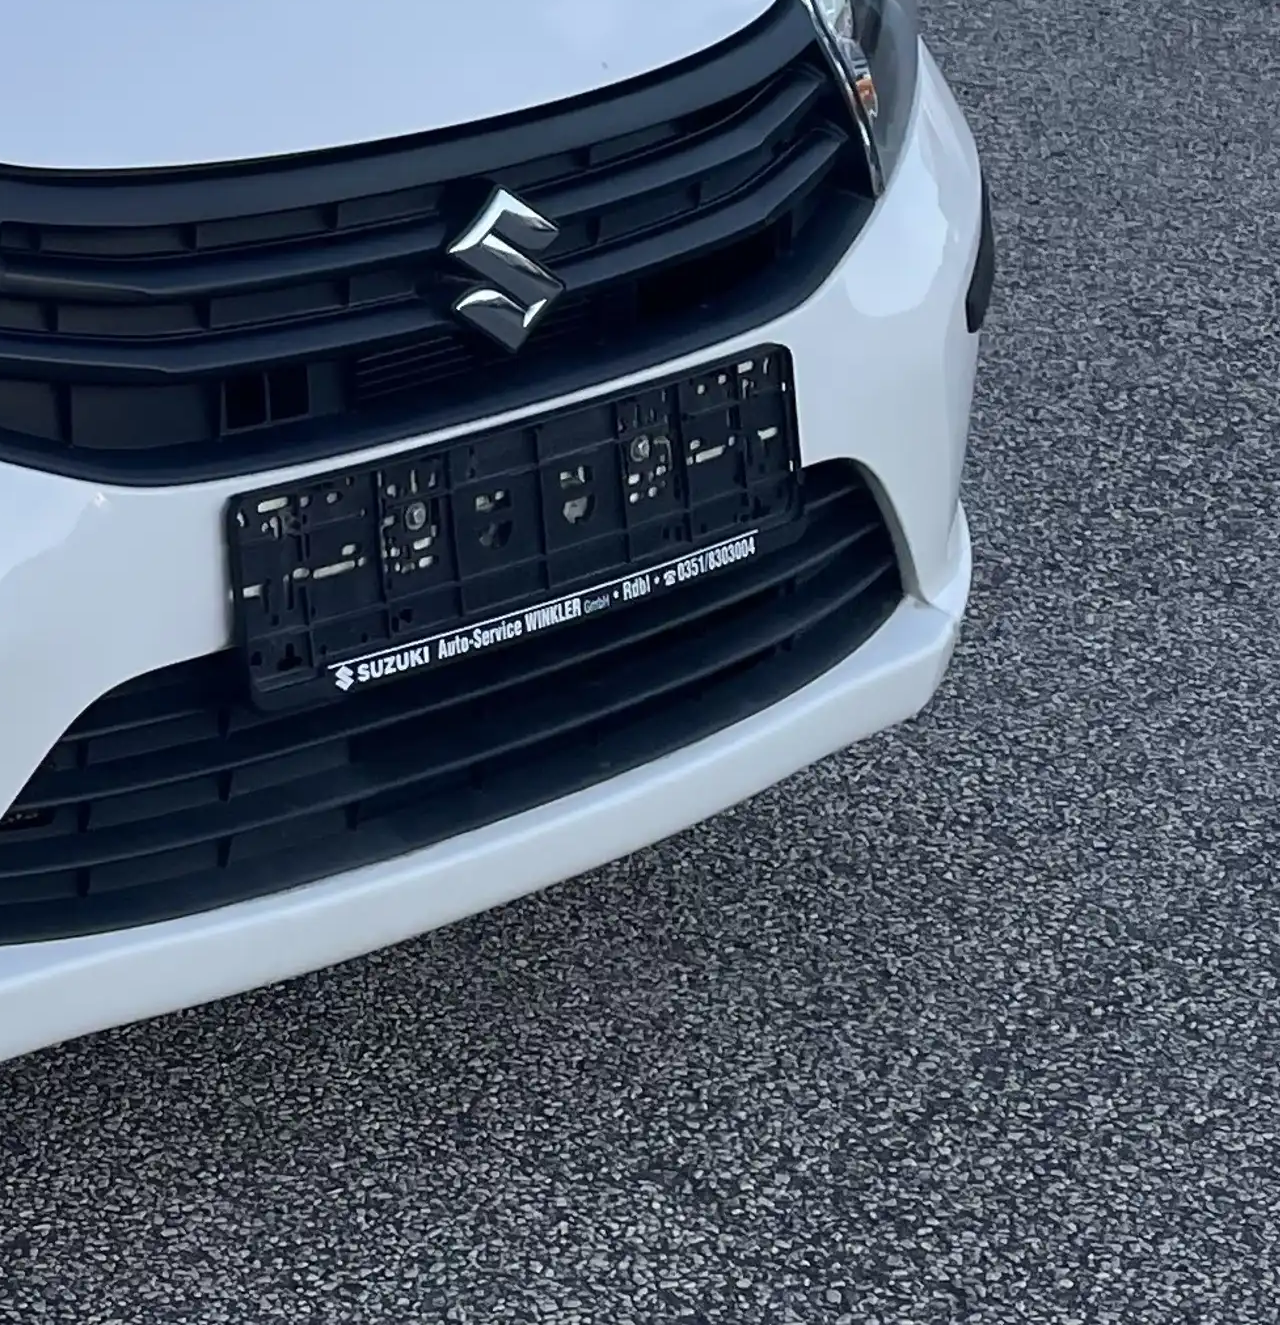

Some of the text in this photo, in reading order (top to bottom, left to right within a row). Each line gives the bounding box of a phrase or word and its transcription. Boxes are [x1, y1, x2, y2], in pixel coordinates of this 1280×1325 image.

[356, 536, 756, 682] SUZUKI Auto-Service WINKLER GmbH Rdbl 0351/8303004
